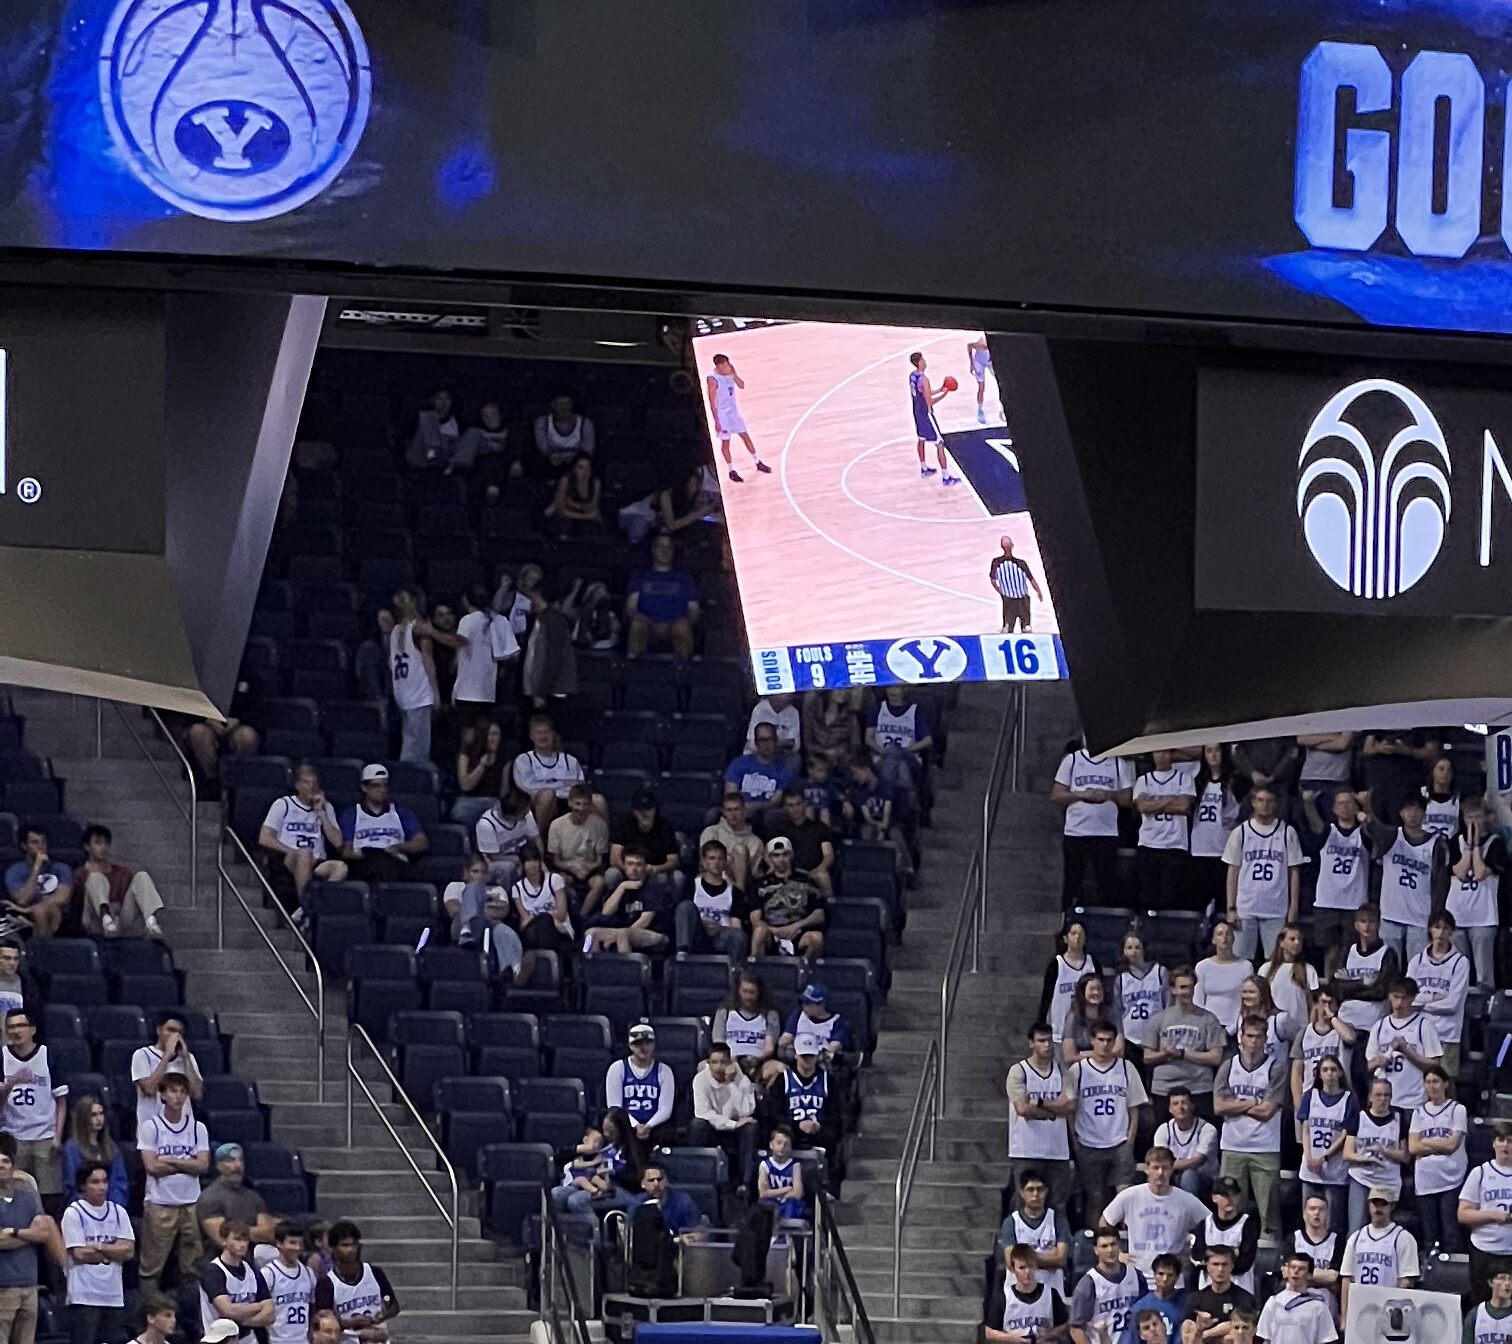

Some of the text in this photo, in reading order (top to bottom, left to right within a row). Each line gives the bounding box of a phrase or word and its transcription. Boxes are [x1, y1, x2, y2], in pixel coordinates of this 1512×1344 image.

[1294, 41, 1485, 258] GO
[795, 645, 833, 662] FOULS
[998, 638, 1040, 676] 16
[765, 650, 784, 692] BONUS
[811, 664, 826, 688] 9
[1199, 806, 1217, 822] 26
[1252, 864, 1273, 881] 26
[1332, 858, 1352, 875] 26
[1399, 868, 1418, 890] 26
[1130, 1003, 1148, 1020] 26
[12, 1088, 35, 1106] 26
[623, 1084, 659, 1099] BYU
[788, 1094, 824, 1109] BYU
[1094, 1099, 1115, 1116] 26
[1312, 1130, 1333, 1149] 26
[1360, 1266, 1380, 1285] 26
[287, 1306, 307, 1324] 26
